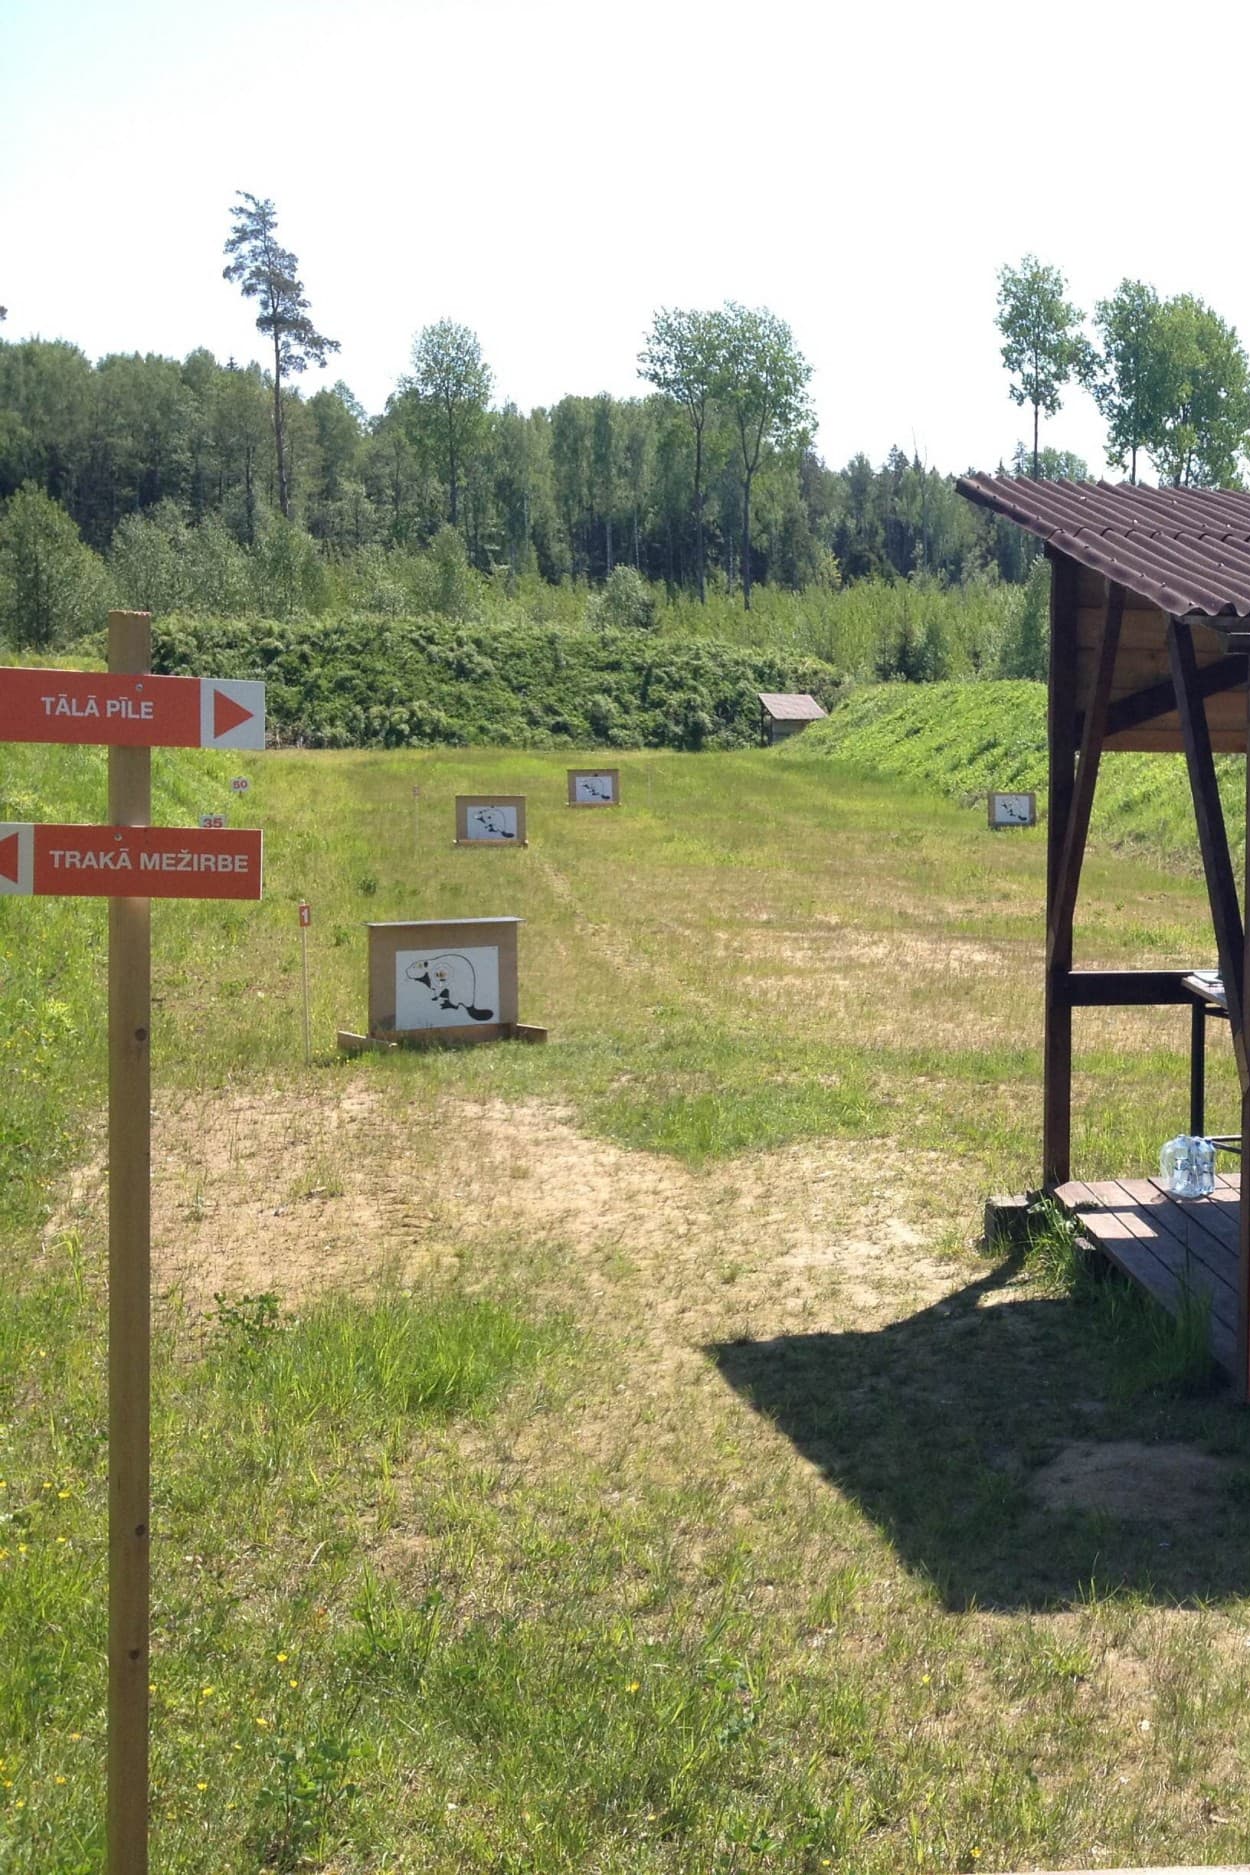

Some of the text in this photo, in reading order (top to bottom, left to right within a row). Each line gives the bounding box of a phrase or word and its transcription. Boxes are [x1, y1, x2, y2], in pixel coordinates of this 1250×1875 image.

[41, 693, 154, 719] TĀLĀ PĪLE
[232, 779, 248, 790] 50
[203, 817, 223, 828] 35
[50, 849, 248, 872] TRAKĀ MEŽIRBE
